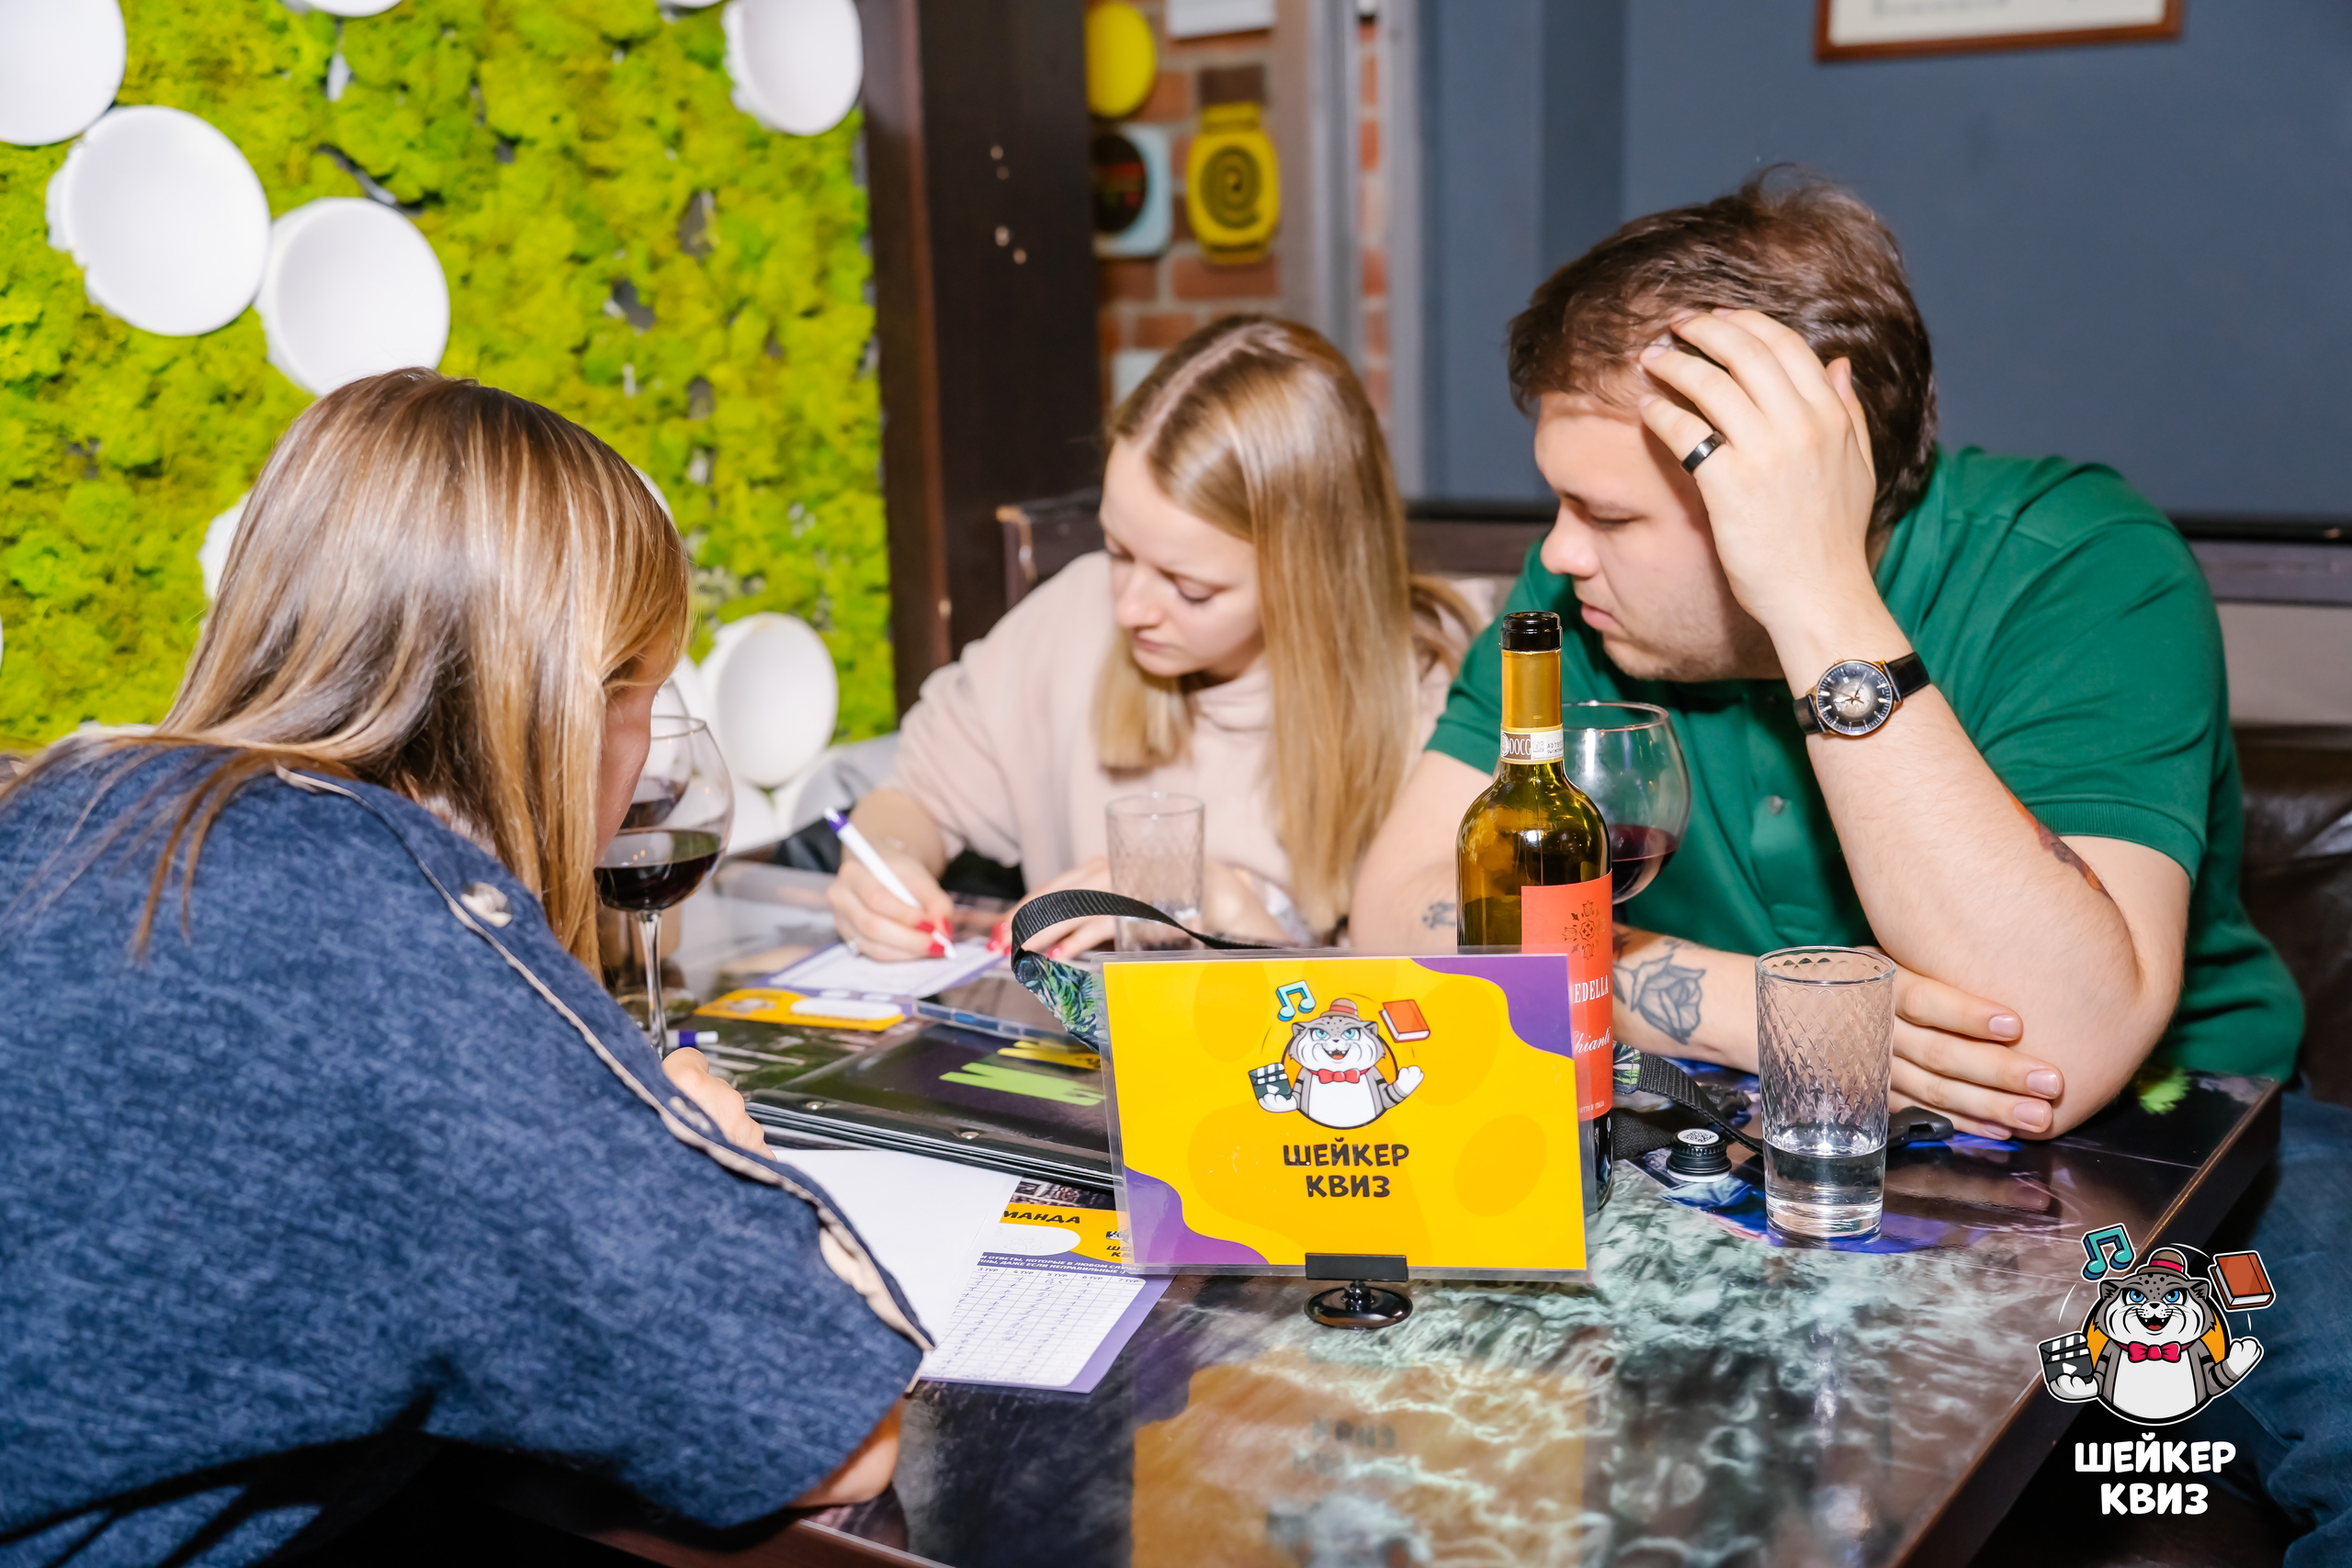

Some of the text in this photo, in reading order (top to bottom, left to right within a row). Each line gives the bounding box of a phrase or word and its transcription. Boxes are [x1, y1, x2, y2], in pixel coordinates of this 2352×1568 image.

[1573, 975, 1609, 1004] EDELLA
[1283, 1137, 1409, 1167] ШЕЙКЕР
[1306, 1175, 1391, 1198] КВИЗ
[1049, 1264, 1118, 1274] НЕПРАВИЛЬНЫЕ
